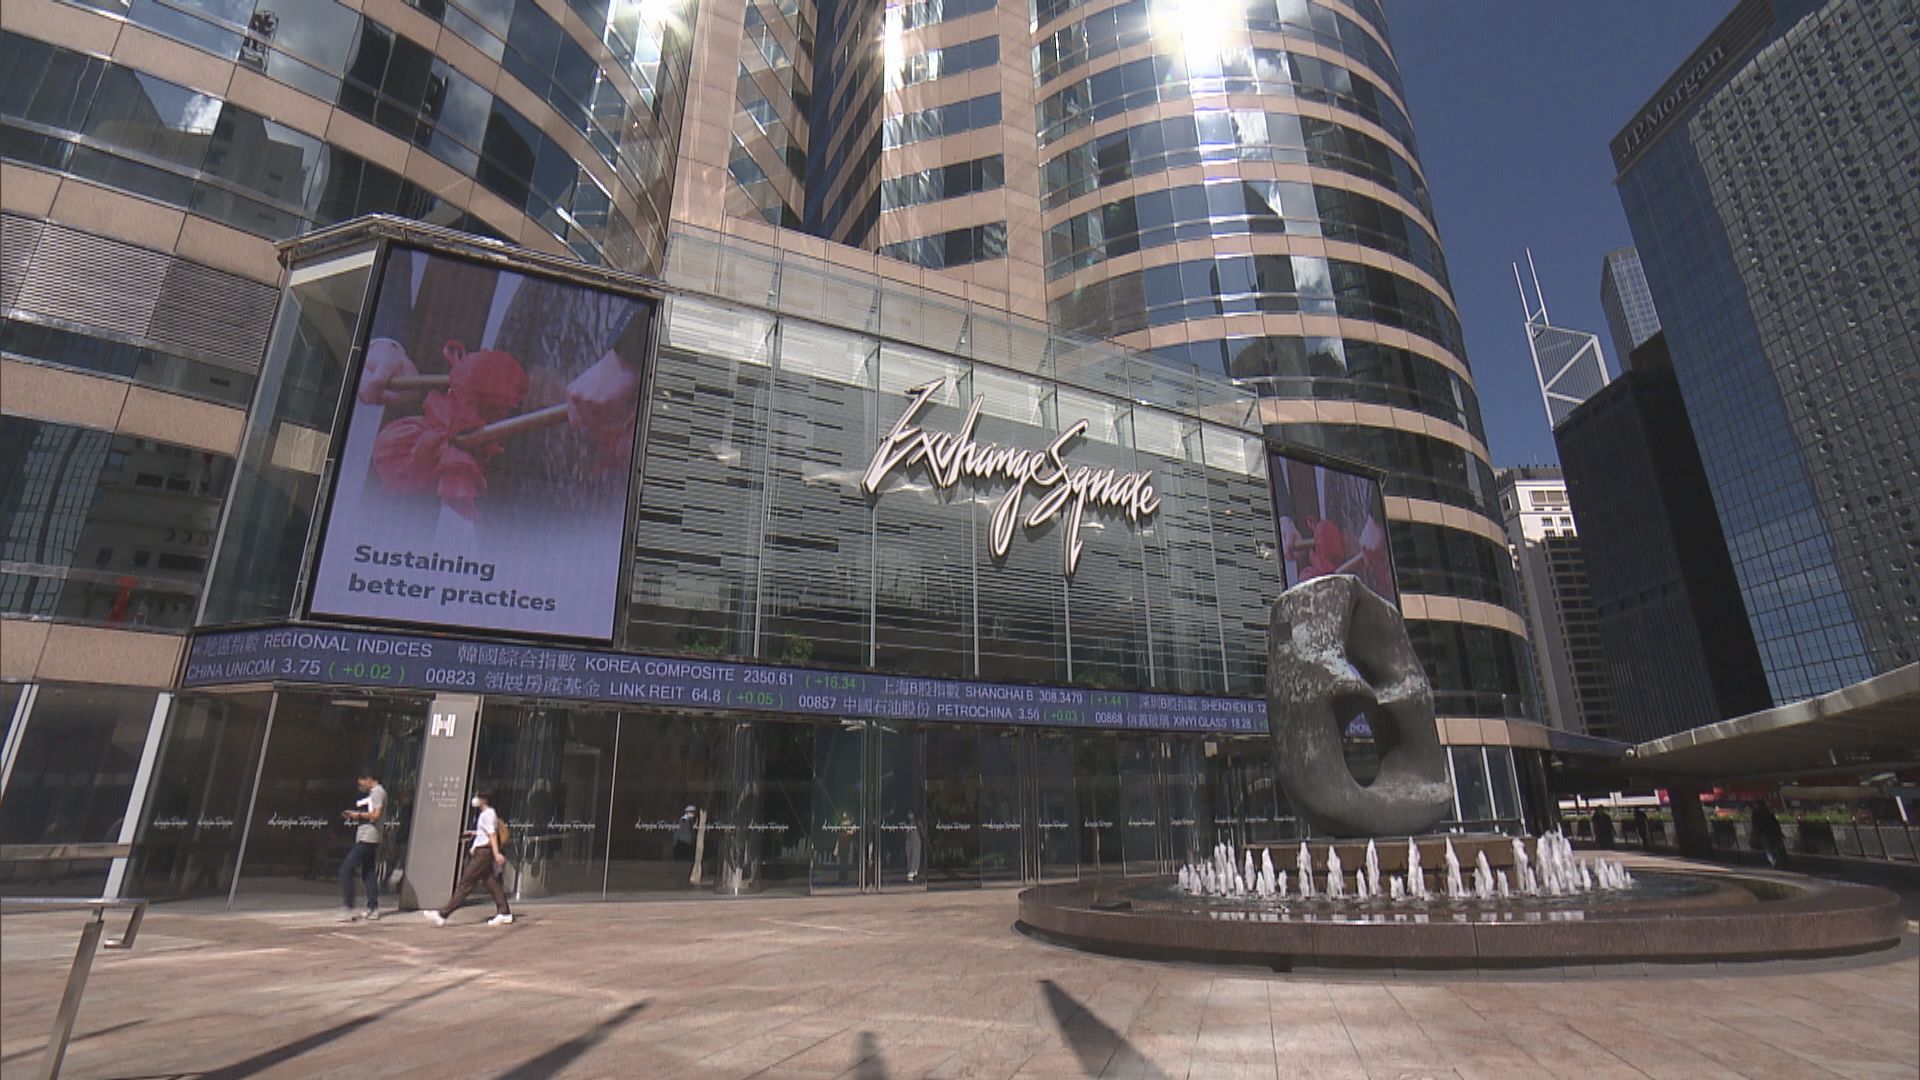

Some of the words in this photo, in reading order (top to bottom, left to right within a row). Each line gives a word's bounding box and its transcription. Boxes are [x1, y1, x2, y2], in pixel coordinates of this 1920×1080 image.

[861, 377, 1052, 557] Exchange
[1024, 417, 1162, 577] Square
[348, 573, 435, 599] better
[440, 587, 556, 612] practices
[354, 544, 496, 582] Sustaining
[187, 663, 223, 680] CHINA
[225, 659, 276, 678] UNICOM
[281, 658, 321, 676] 3.75
[425, 667, 476, 686] 00823
[610, 682, 646, 698] LINK
[650, 684, 684, 700] REIT
[691, 687, 721, 702] 64.8
[799, 694, 837, 709] 00857
[937, 704, 1013, 720] PETROCHINA
[1173, 715, 1198, 729] XINYI
[264, 632, 349, 652] REGIONAL
[356, 637, 433, 658] INDICES
[585, 656, 641, 674] KOREA
[645, 661, 735, 682] COMPOSITE
[965, 686, 1024, 701] SHANGHAI
[1026, 689, 1034, 701] B
